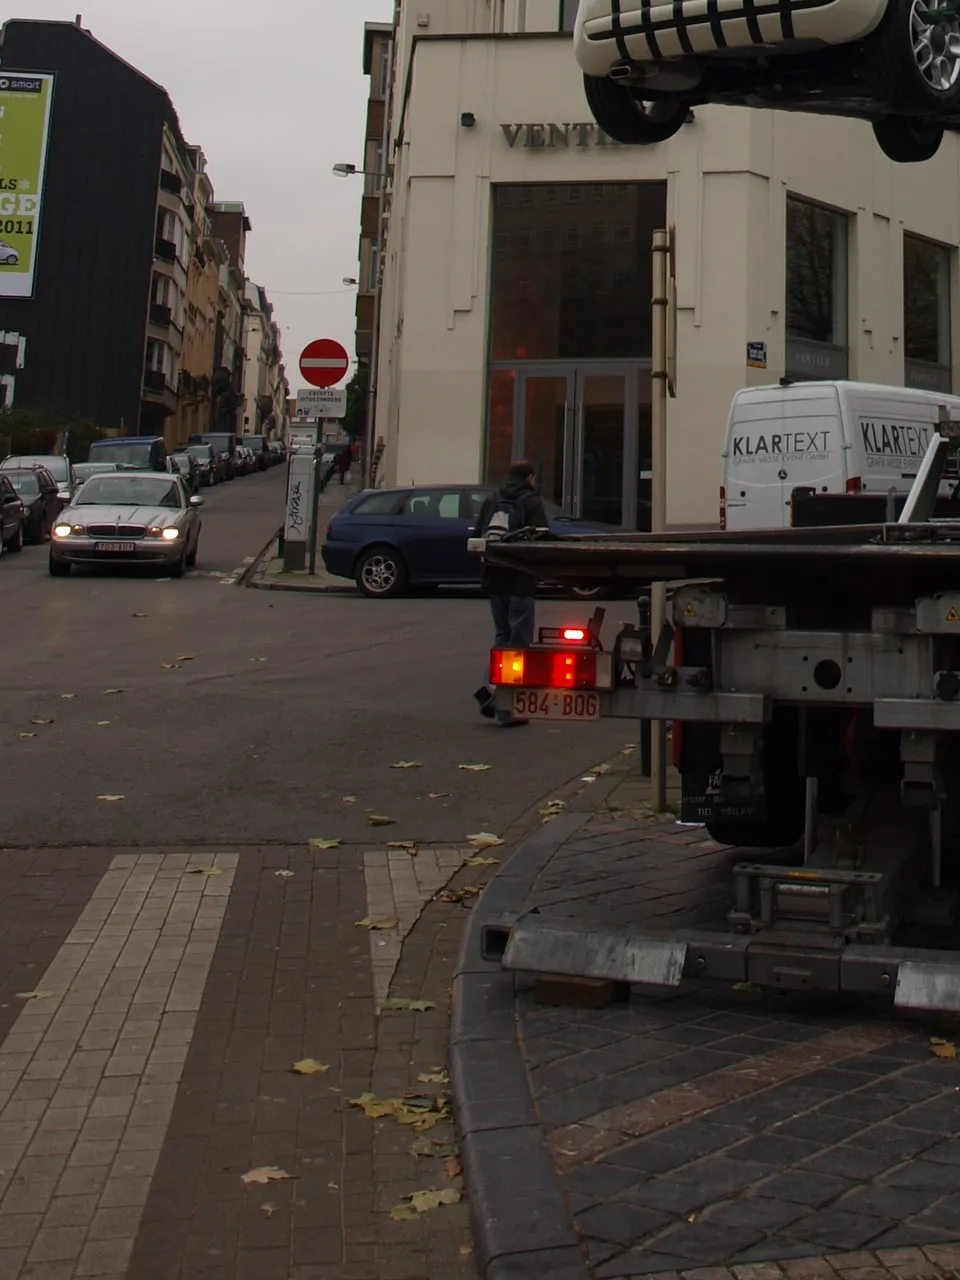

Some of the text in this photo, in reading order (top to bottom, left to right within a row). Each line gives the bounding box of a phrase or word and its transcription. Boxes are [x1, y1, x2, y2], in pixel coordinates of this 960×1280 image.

[11, 80, 40, 89] smart
[499, 122, 622, 148] VENTI
[733, 431, 831, 457] KLARTEXT
[861, 422, 929, 456] KLARTEXT
